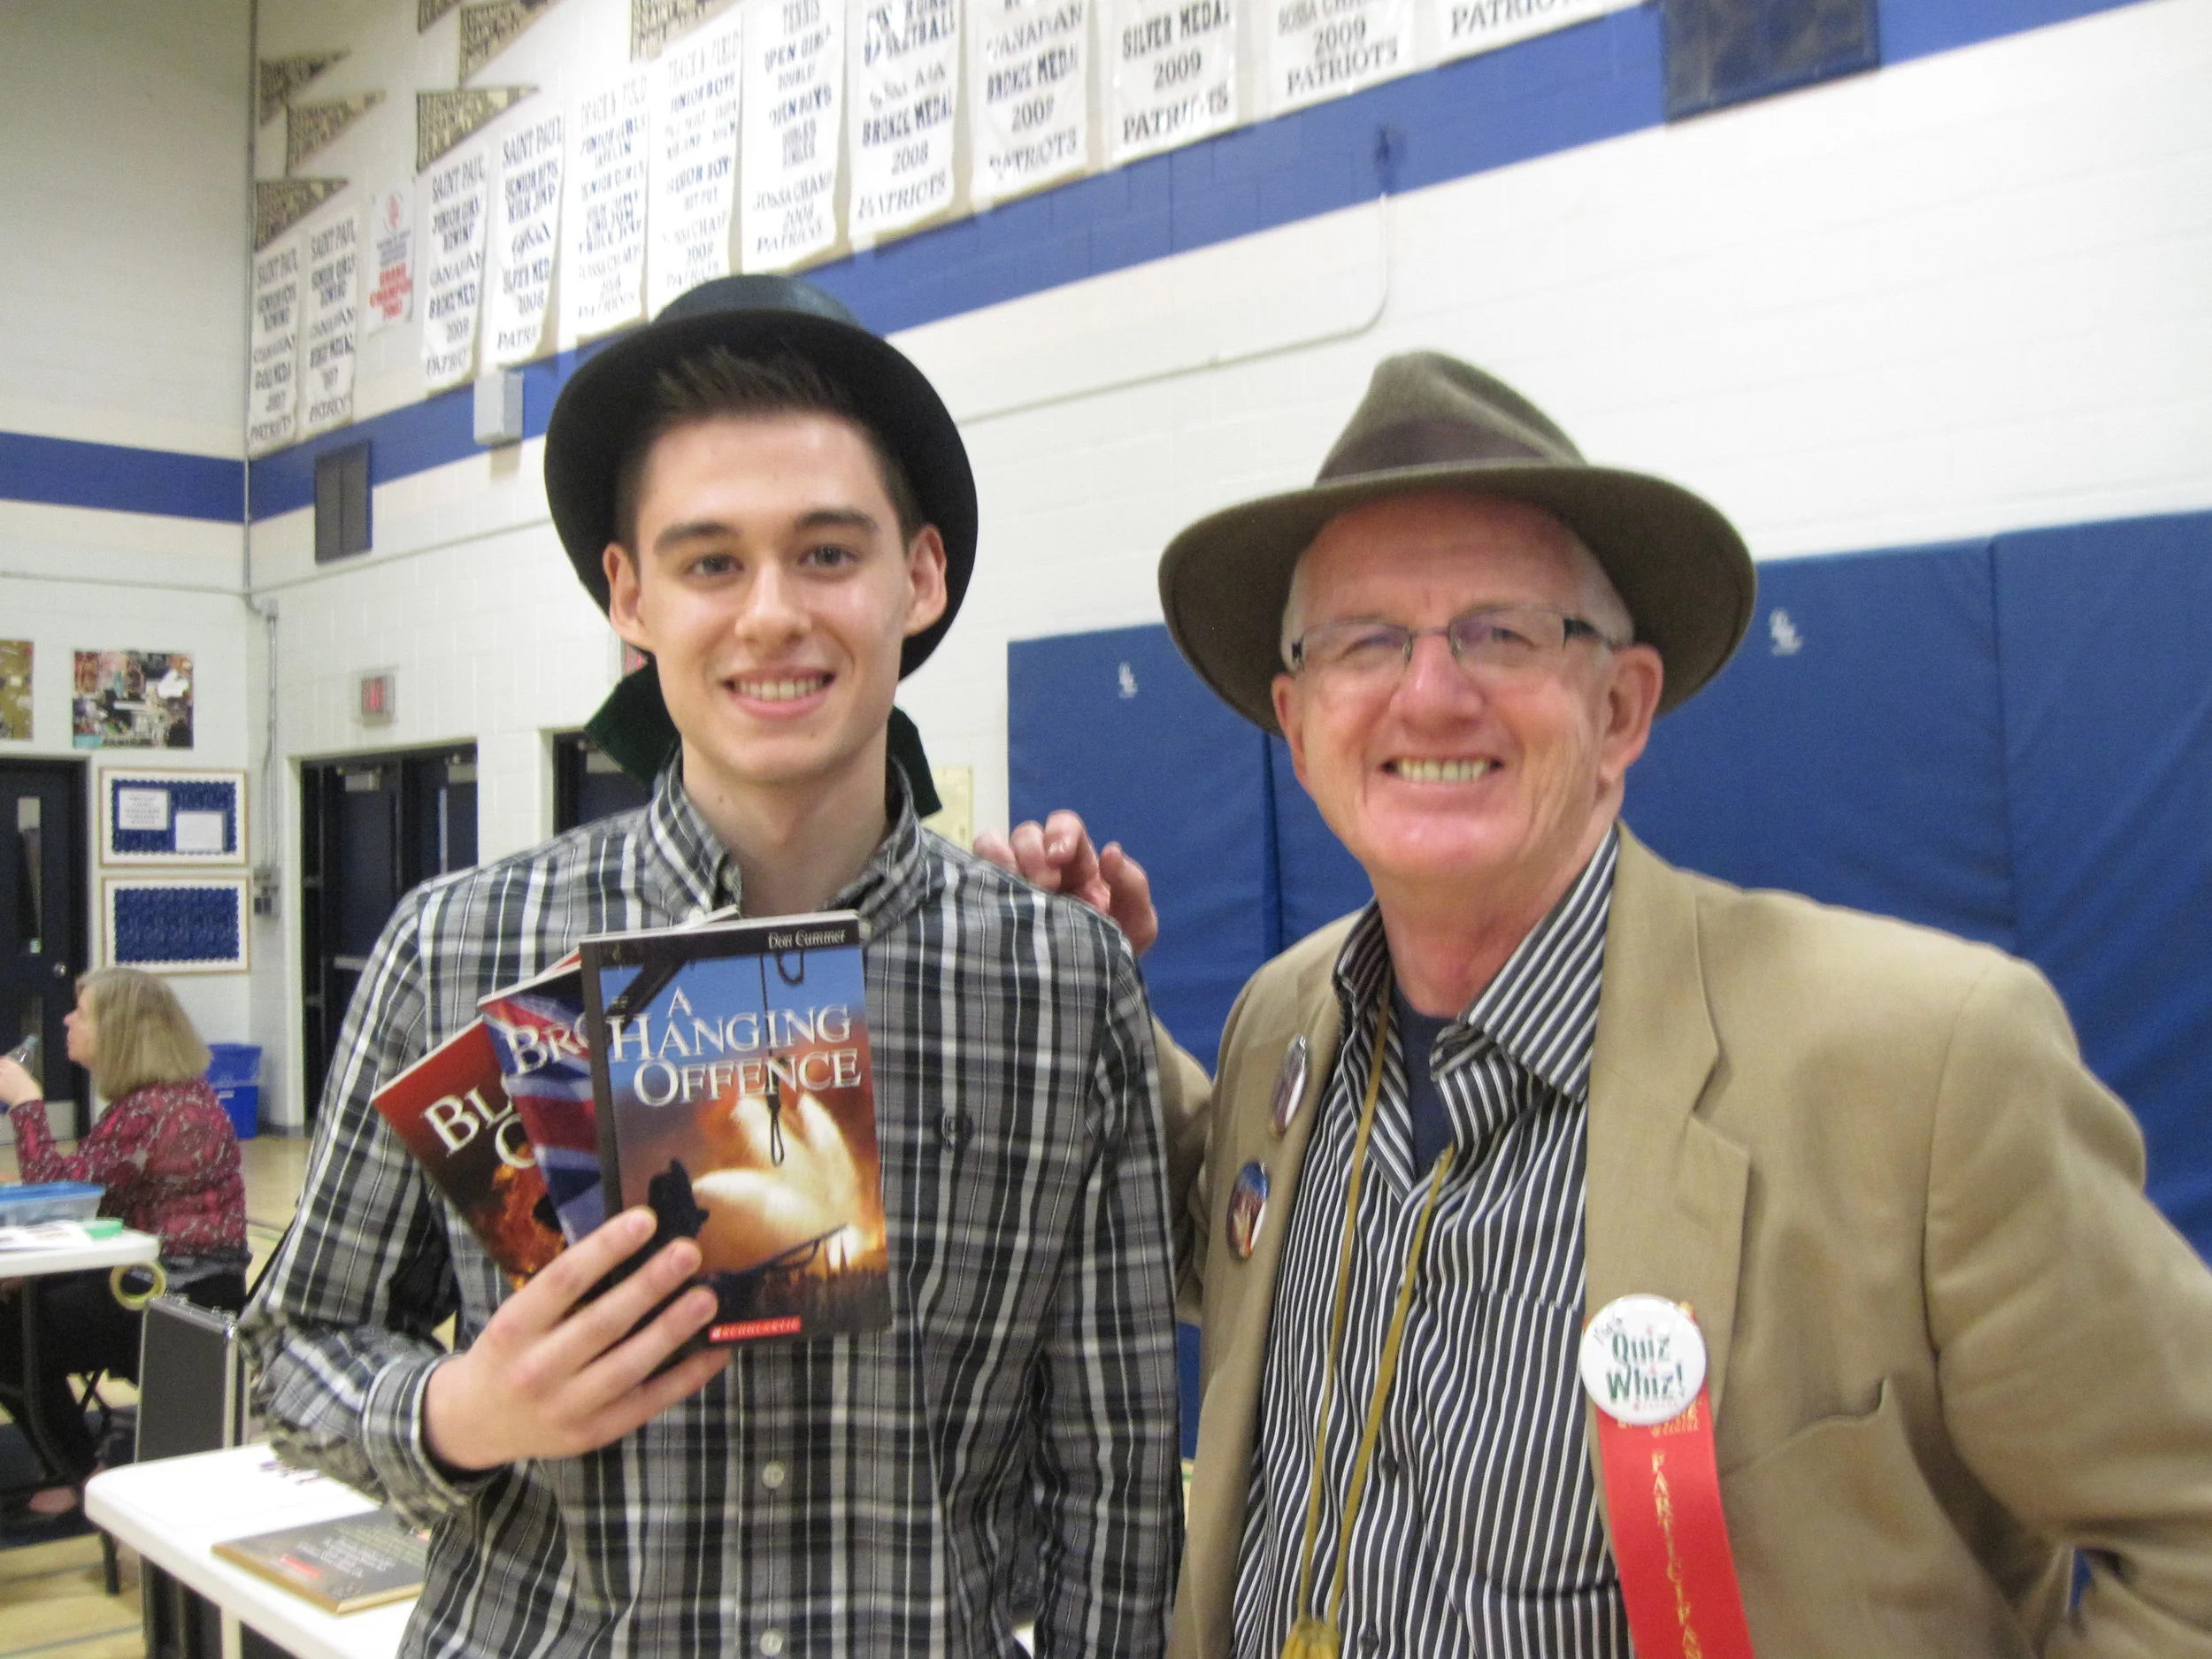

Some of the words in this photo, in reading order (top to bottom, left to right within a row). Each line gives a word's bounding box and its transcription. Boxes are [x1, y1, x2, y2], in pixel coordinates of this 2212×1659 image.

[1122, 13, 1172, 61] SILVER
[1314, 15, 1366, 58] 2009
[1154, 48, 1202, 91] 2009
[1287, 35, 1398, 96] PATRIOTS
[914, 87, 952, 130] MEDAL
[1124, 83, 1229, 142] PATRIOTS
[503, 128, 534, 168] SAINT
[891, 139, 929, 175] 2008
[989, 127, 1078, 179] PATRIOTS
[858, 169, 946, 219] PATRIOTS
[768, 932, 793, 949] Don
[668, 986, 693, 1018] A
[605, 1003, 852, 1063] HANGING
[634, 1048, 863, 1107] OFFENCE
[1611, 1325, 1671, 1368] Quiz
[1606, 1360, 1685, 1403] Whiz!
